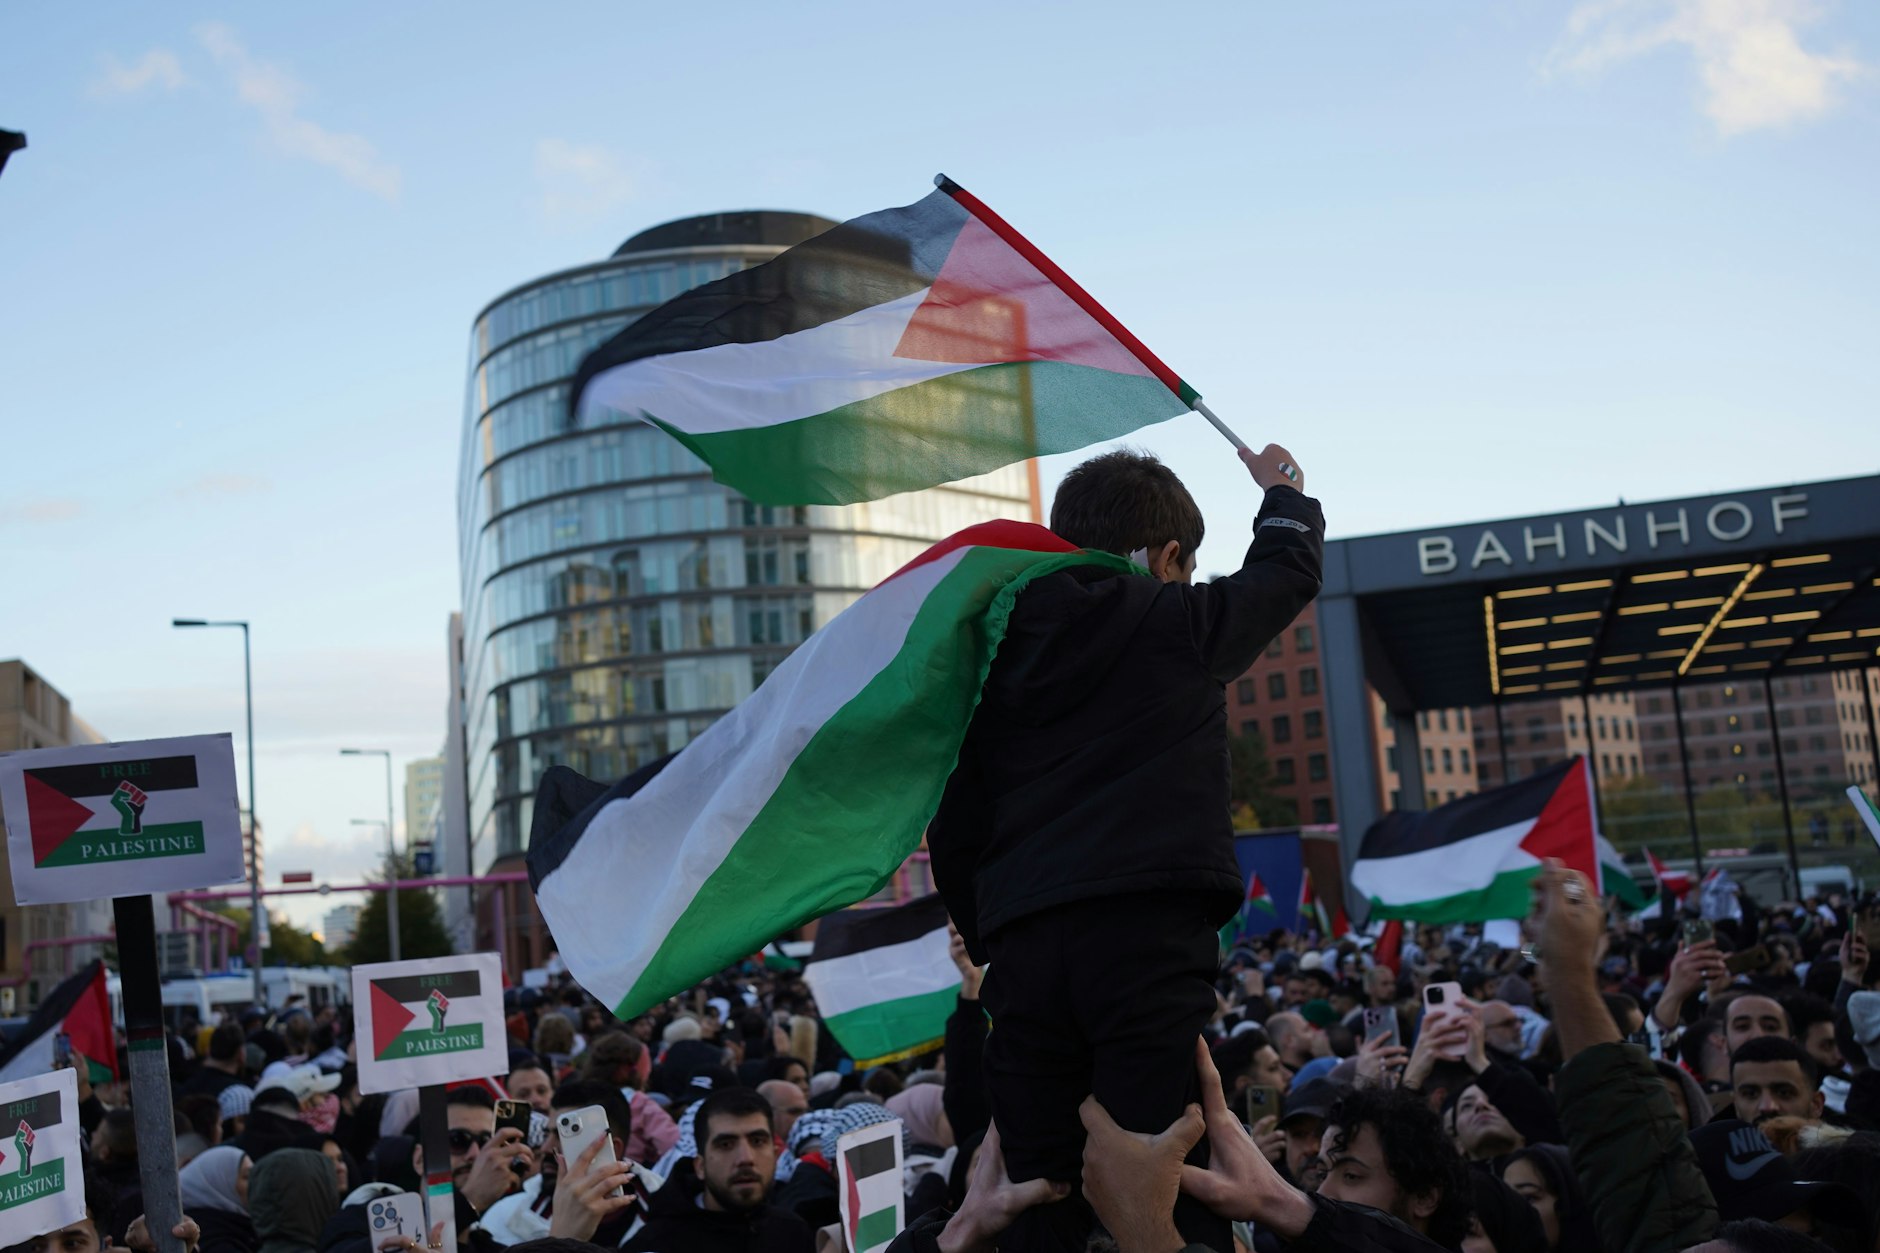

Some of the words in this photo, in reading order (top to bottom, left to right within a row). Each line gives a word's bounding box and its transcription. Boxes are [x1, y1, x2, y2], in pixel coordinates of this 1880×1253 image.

[1417, 493, 1809, 575] BAHNHOF
[100, 762, 151, 779] FREE
[81, 835, 197, 859] PALESTINE
[419, 974, 454, 988] FREE
[405, 1033, 480, 1054] PALESTINE
[8, 1099, 39, 1119] FREE
